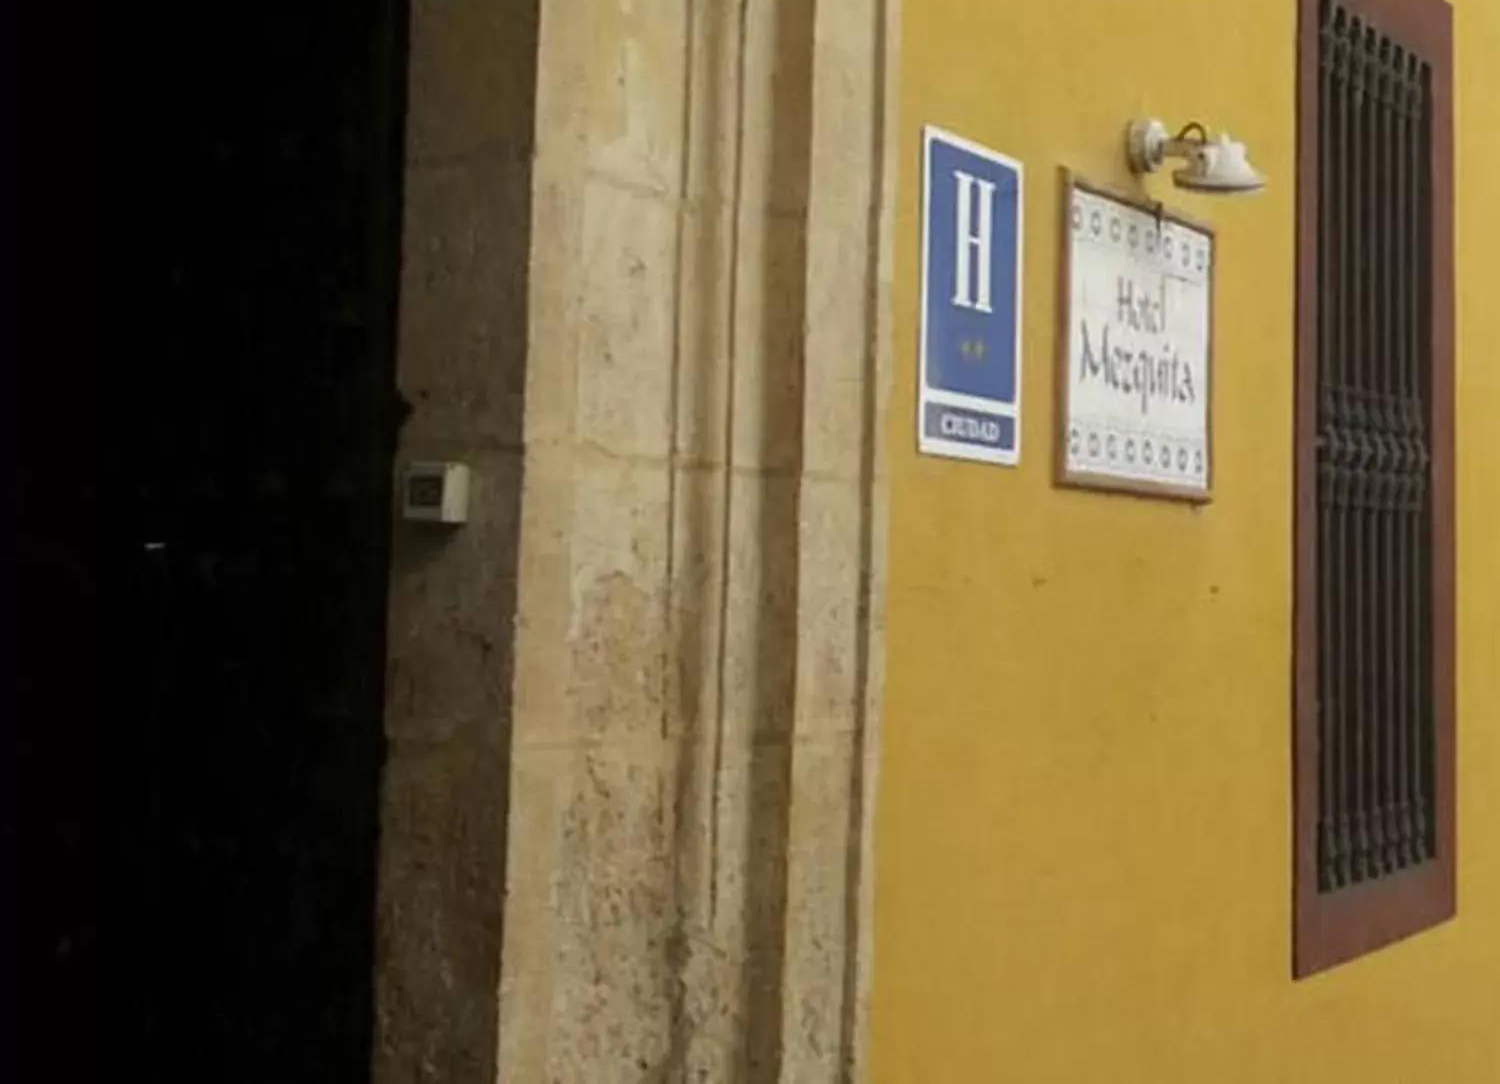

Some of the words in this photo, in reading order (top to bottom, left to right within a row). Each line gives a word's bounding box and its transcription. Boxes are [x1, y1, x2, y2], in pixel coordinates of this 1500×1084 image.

[951, 171, 996, 313] H
[1117, 272, 1168, 334] Hotel
[1079, 318, 1196, 415] Mezquita
[940, 412, 1000, 443] CIUDAD
